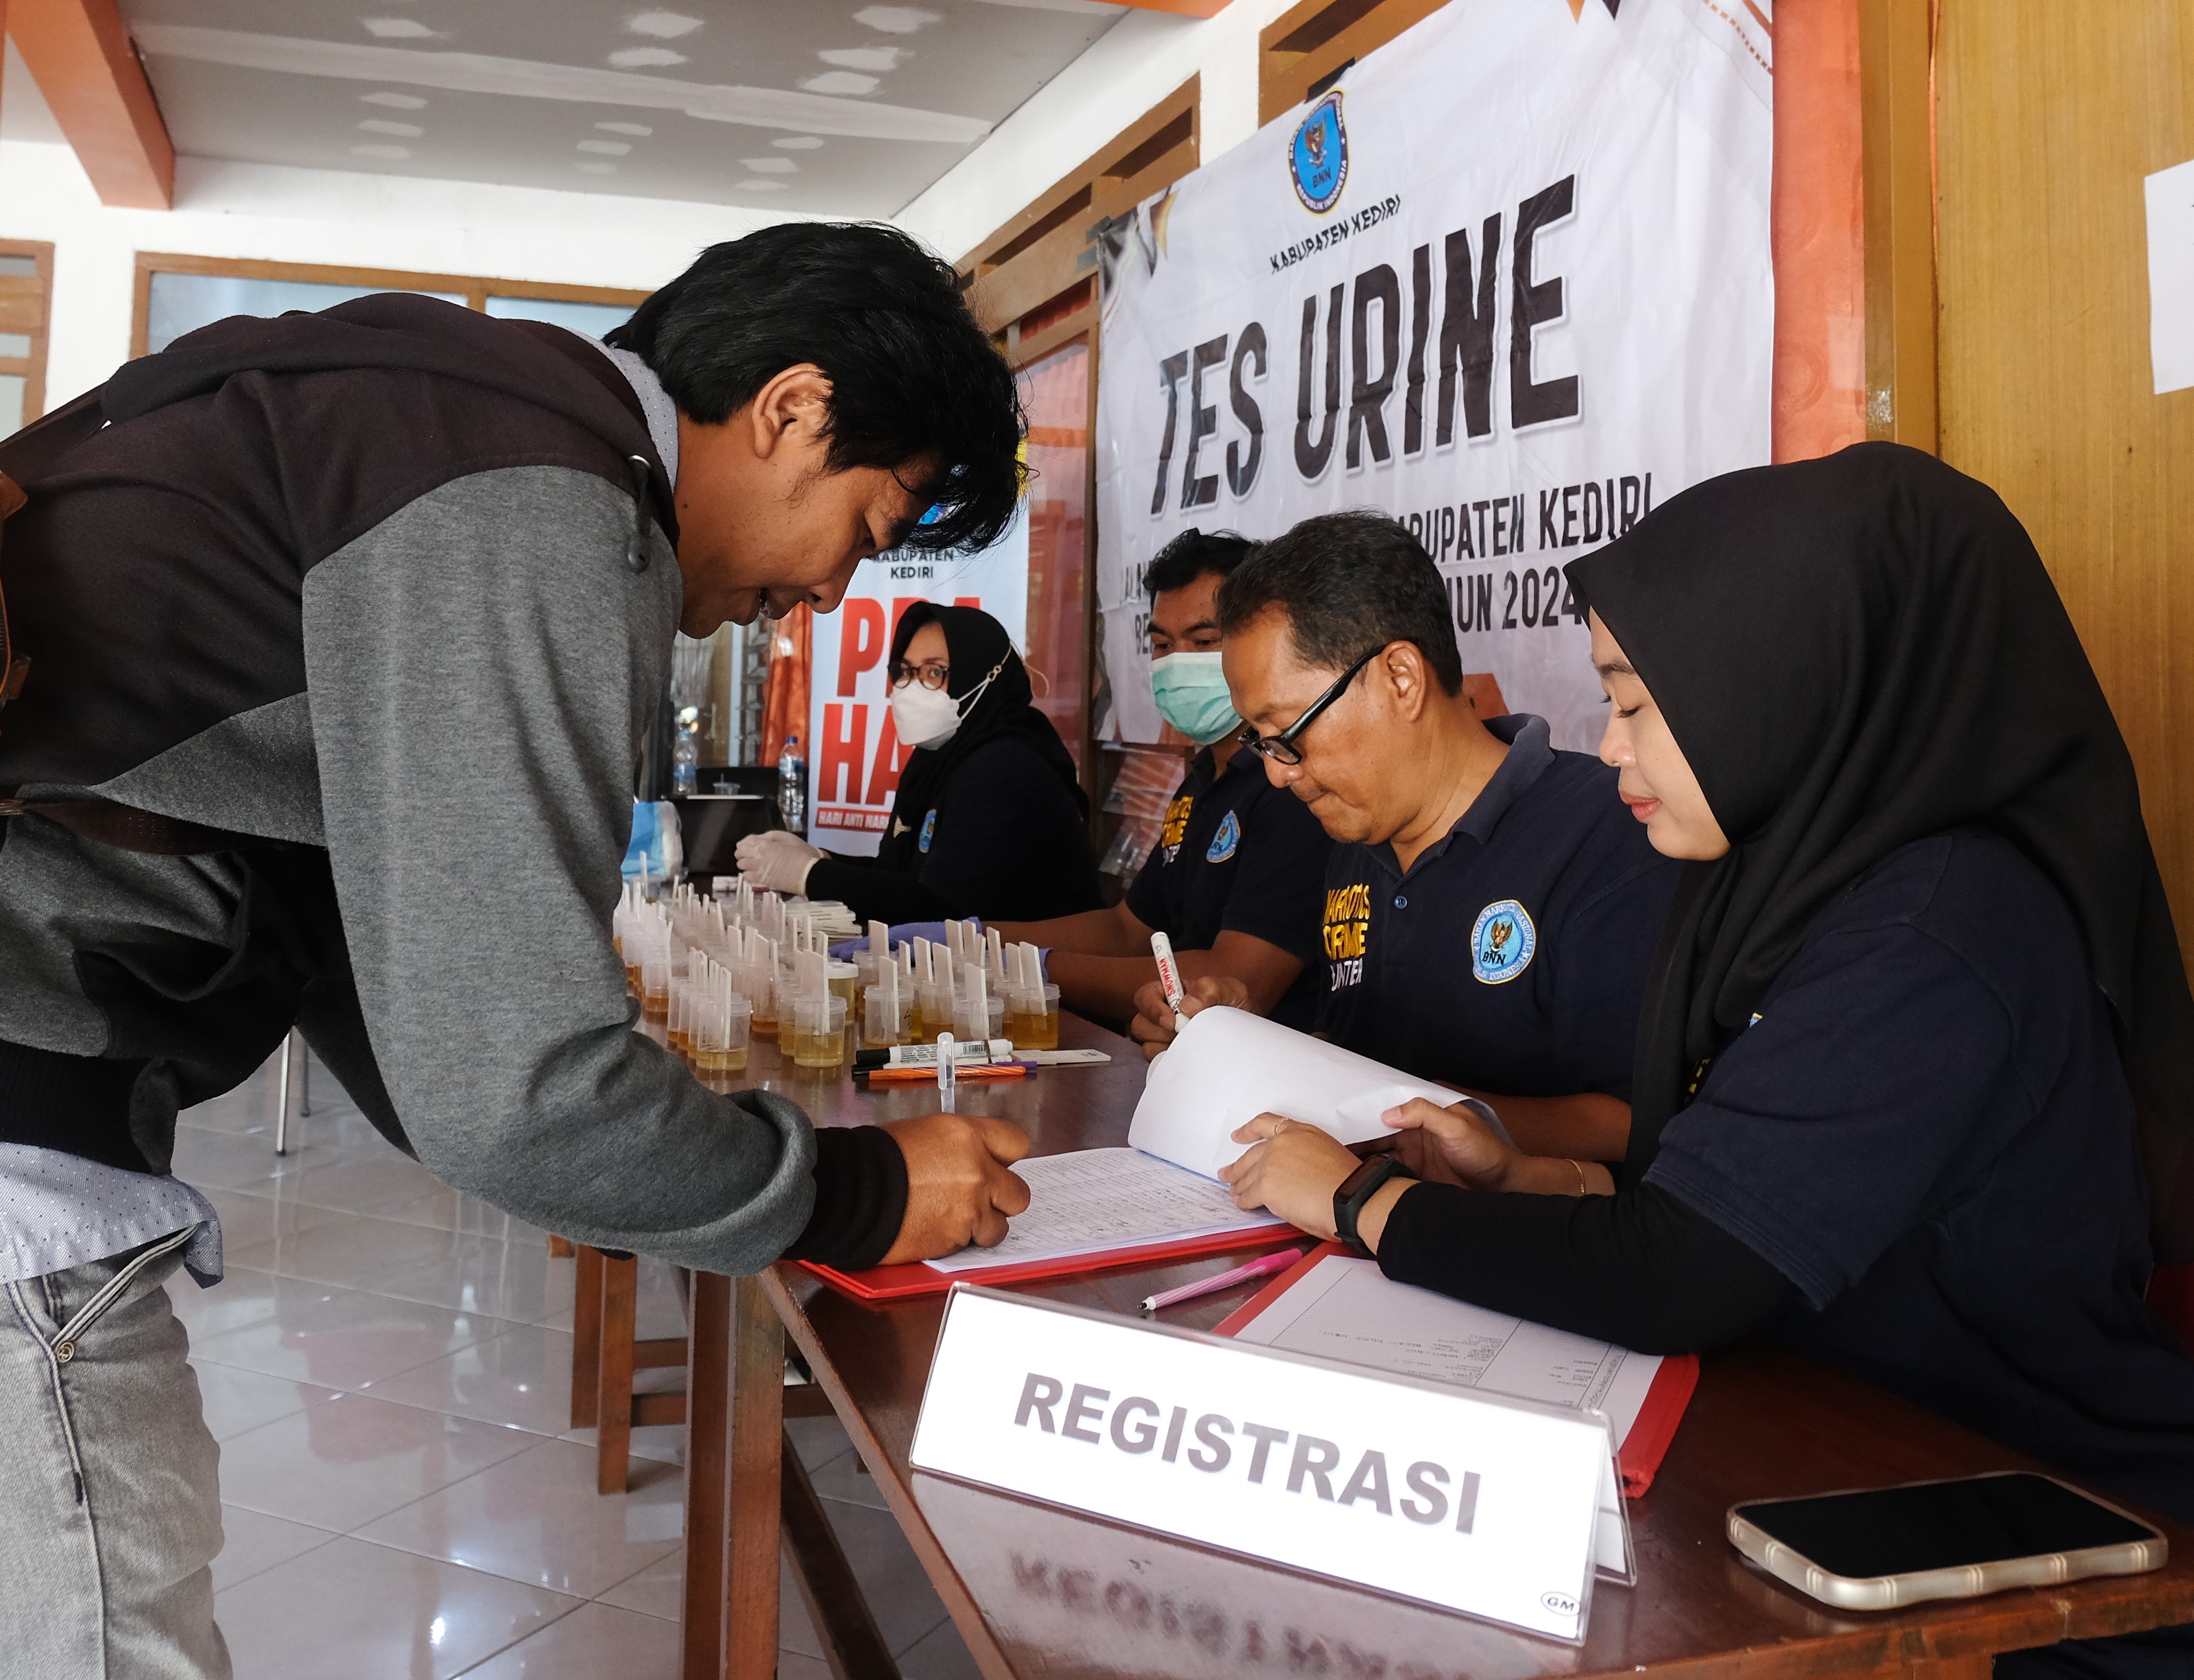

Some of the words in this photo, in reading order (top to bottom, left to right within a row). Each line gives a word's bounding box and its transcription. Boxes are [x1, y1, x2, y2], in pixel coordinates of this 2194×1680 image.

[1312, 168, 1332, 189] BNN
[1270, 219, 1349, 274] KABUPATEN
[1351, 194, 1401, 235] KEDIRI
[1151, 322, 1267, 514] TES
[1294, 174, 1579, 479] URINE
[1539, 473, 1652, 550] KEDIRI
[891, 567, 934, 579] KEDIRI
[1160, 958, 1175, 997] SNOWMAN
[1482, 951, 1507, 965] BNN
[1014, 1372, 1481, 1534] REGISTRASI
[1547, 1596, 1575, 1612] GM
